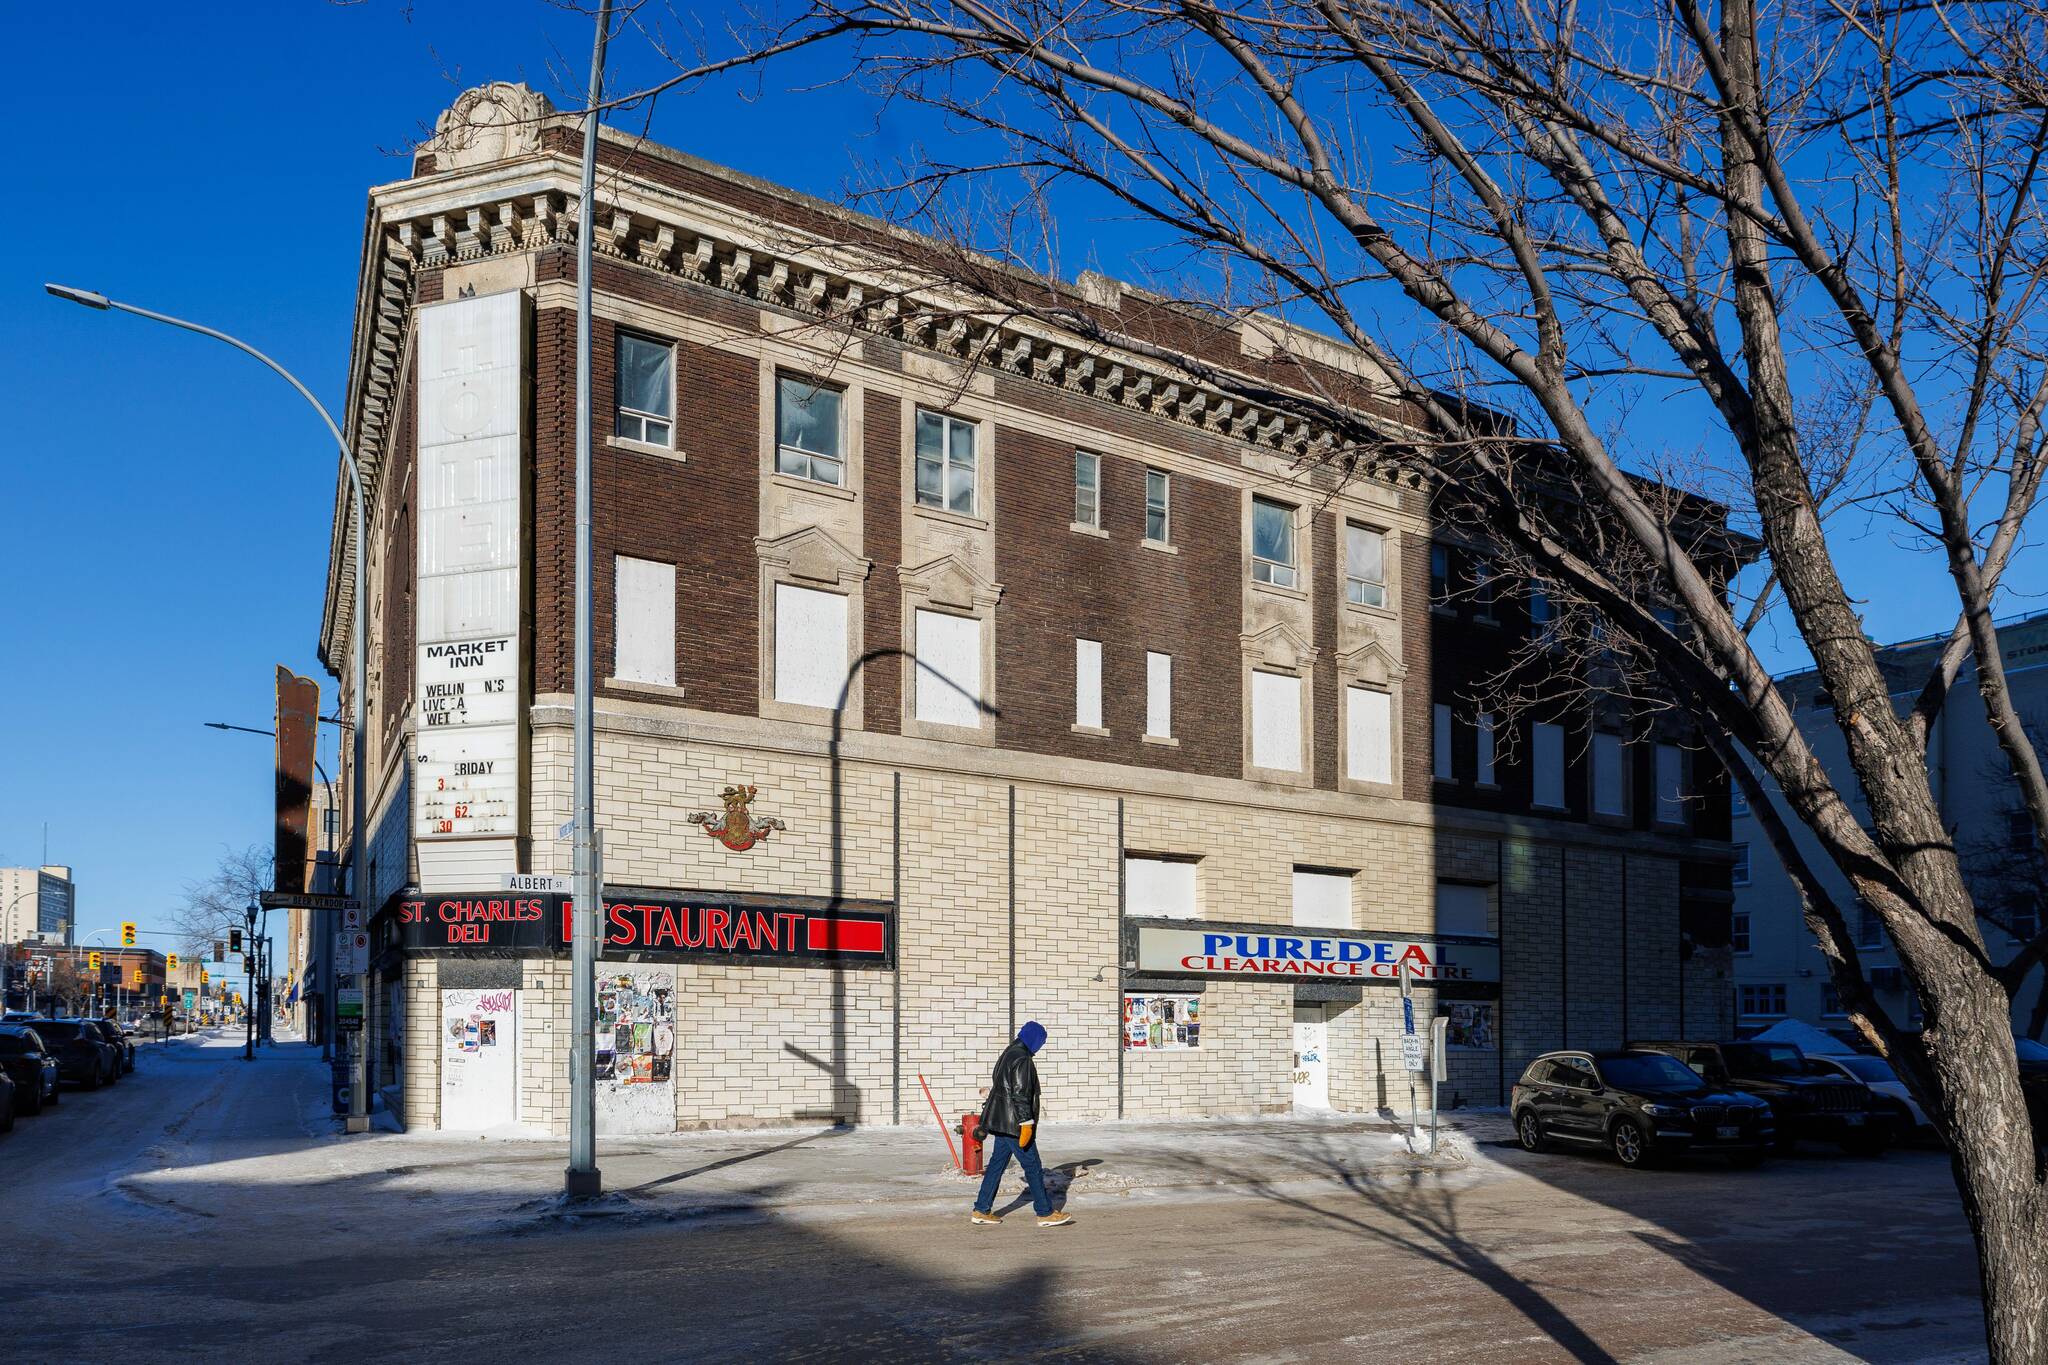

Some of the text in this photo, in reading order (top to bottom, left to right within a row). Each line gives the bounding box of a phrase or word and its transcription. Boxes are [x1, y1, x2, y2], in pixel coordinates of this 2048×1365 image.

[427, 639, 509, 658] MARKET
[450, 655, 484, 669] INN
[426, 682, 465, 698] WELLIN
[454, 805, 468, 819] 62
[439, 820, 453, 833] 30
[510, 877, 553, 890] ALBERT
[293, 896, 312, 906] BEER
[315, 897, 345, 909] VENDOR
[399, 899, 543, 923] ST. CHARLES
[448, 923, 490, 943] DELI
[562, 901, 805, 952] STAURANT
[1202, 933, 1457, 967] PUREDEAL
[1181, 955, 1363, 976] CLEARANCE
